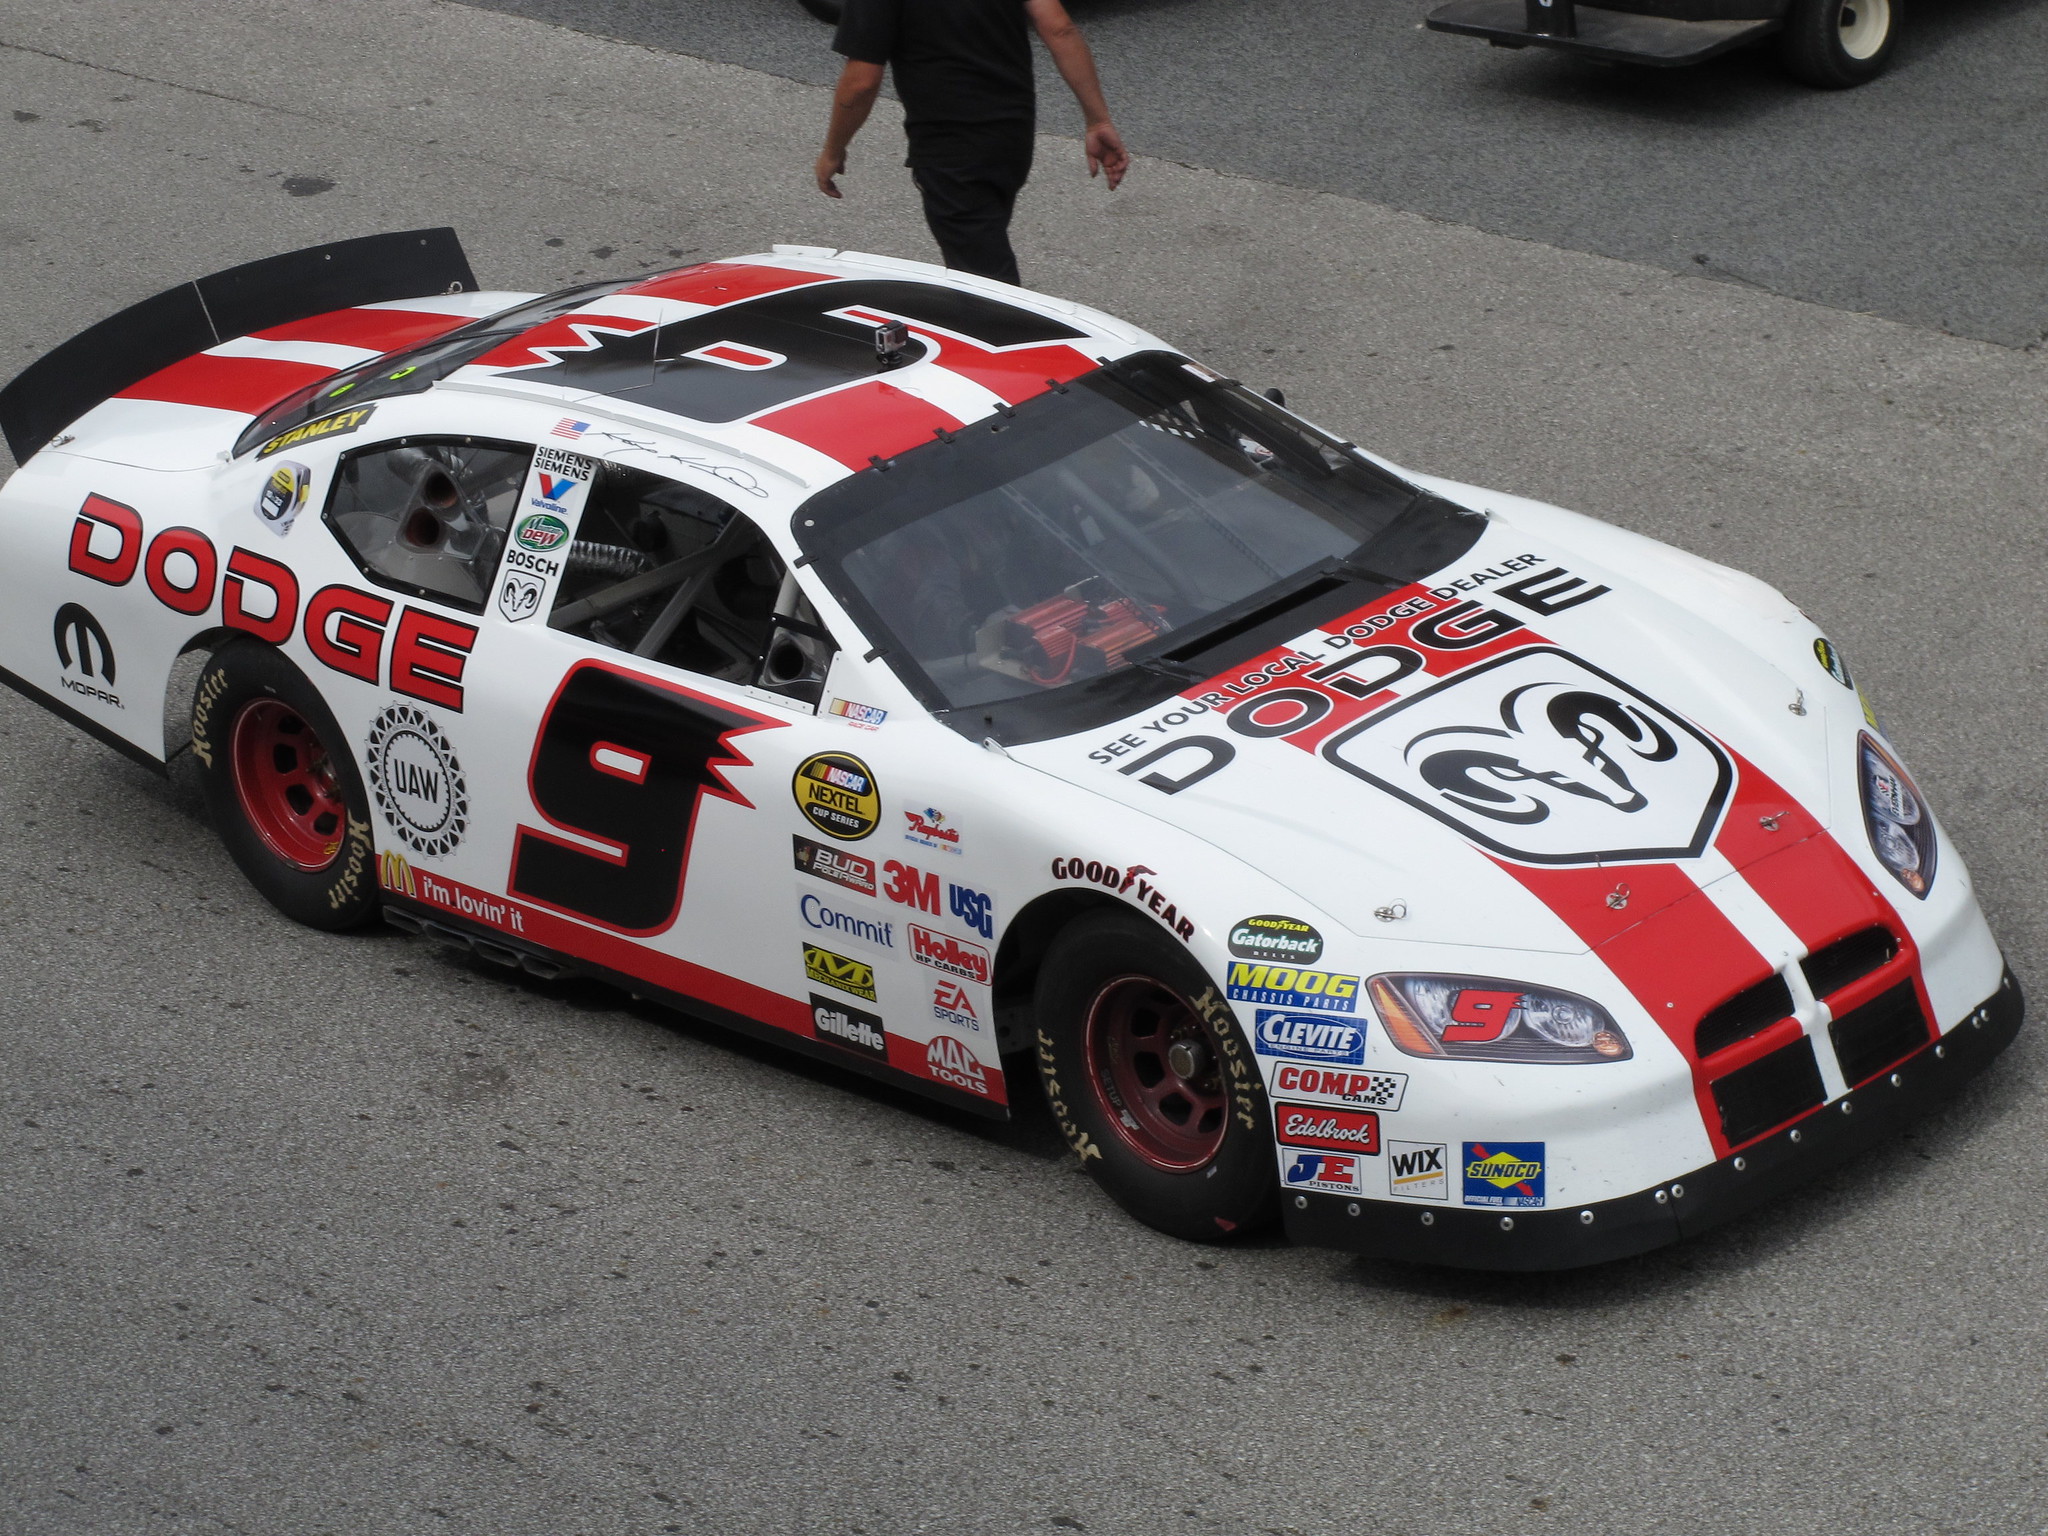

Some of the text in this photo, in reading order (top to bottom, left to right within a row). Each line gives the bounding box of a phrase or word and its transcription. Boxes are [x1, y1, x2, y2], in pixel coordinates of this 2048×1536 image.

[263, 409, 368, 454] STANLEY
[534, 457, 589, 481] SIEMENS
[537, 446, 592, 470] SIEMENS
[531, 498, 568, 515] Valvoline
[506, 549, 560, 577] BOSCH
[69, 491, 480, 715] DODGE
[1088, 552, 1547, 765] SEE YOUR LOCAL DODGE DEALER
[60, 675, 121, 707] MOPAR
[1116, 566, 1613, 796] DODGE
[846, 703, 885, 726] NASCAR
[394, 758, 438, 804] UAW
[827, 767, 865, 793] NASCAR
[506, 657, 793, 939] 9
[809, 782, 863, 815] NEXTEL
[813, 806, 860, 829] CUP SERIES
[815, 849, 868, 878] BUD
[883, 859, 941, 917] 3M
[423, 876, 525, 932] i'm lovin' it
[949, 883, 993, 939] USG
[801, 894, 894, 948] Commit
[1248, 918, 1310, 932] GOODYEAR
[913, 927, 988, 982] Holley
[1232, 928, 1321, 954] Gatorback
[1253, 950, 1295, 960] BELTS
[915, 953, 976, 979] HP CARBS
[1228, 962, 1358, 998] MOOG
[933, 980, 977, 1018] EA
[1233, 988, 1350, 1011] CHASSIS PARTS
[814, 1007, 884, 1051] Gillette
[933, 1006, 979, 1032] SPORTS
[1441, 988, 1527, 1043] 9
[1263, 1013, 1357, 1050] CLEVITE
[927, 1037, 986, 1081] MAC
[929, 1065, 989, 1094] TOOLS
[1279, 1067, 1371, 1097] COMP
[1342, 1092, 1388, 1106] CAMS
[1284, 1113, 1371, 1144] Edelbrock
[1287, 1154, 1355, 1184] JE
[1391, 1147, 1443, 1177] WIX
[1468, 1162, 1540, 1178] SUNOCO
[1308, 1180, 1360, 1192] PISTONS
